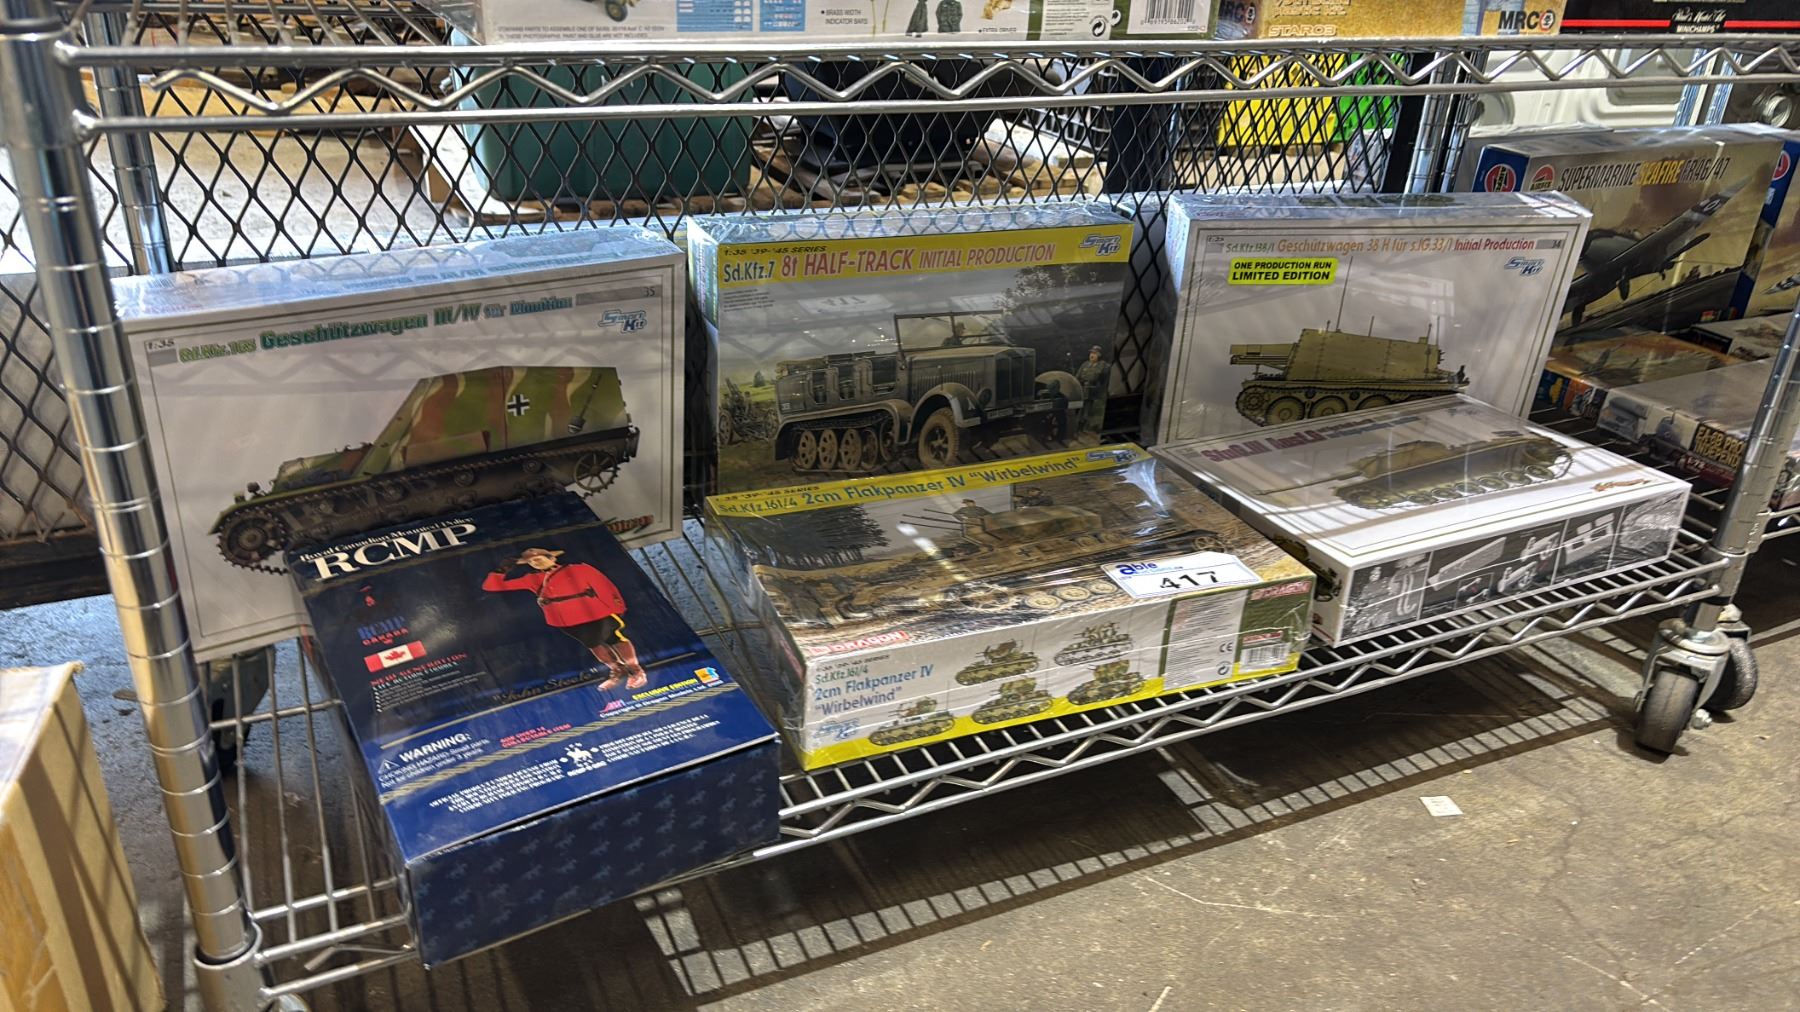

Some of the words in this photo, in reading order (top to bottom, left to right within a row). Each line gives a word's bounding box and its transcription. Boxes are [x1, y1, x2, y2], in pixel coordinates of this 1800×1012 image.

[1498, 11, 1539, 30] MRC
[1557, 163, 1641, 192] SUPERMARINE
[1637, 160, 1686, 187] SEAFIRE
[790, 246, 828, 254] SERIES
[1454, 238, 1481, 251] Initial
[1482, 237, 1535, 250] Production
[723, 260, 775, 282] Sd.Kfz.7
[781, 254, 797, 276] 8t
[803, 248, 915, 276] HALF-TRACK
[918, 250, 961, 269] INITIAL
[966, 244, 1057, 267] PRODUCTION
[1234, 261, 1253, 270] ONE
[1254, 261, 1311, 270] PRODUCTION
[1313, 261, 1333, 269] RUN
[1232, 271, 1280, 281] LIMITED
[1282, 271, 1330, 281] EDITION
[603, 311, 645, 322] Smart
[623, 319, 645, 332] Kit
[260, 314, 429, 350] Geschützwagen
[802, 489, 841, 505] 2cm
[844, 477, 944, 500] Flakpanzer
[948, 474, 966, 489] IV
[299, 547, 335, 563] Royal
[335, 534, 390, 554] Canadian
[390, 522, 438, 541] Mounted
[439, 516, 475, 531] Police
[314, 523, 478, 582] RCMP
[1115, 562, 1158, 576] able
[1160, 571, 1219, 589] 417
[830, 631, 903, 653] DRAGON
[632, 685, 669, 701] EXCLUSIVE
[668, 678, 699, 692] EDITION
[815, 686, 841, 701] 2cm
[846, 671, 918, 693] Flakpanzer
[919, 663, 935, 679] IV
[599, 704, 635, 718] Copyright
[399, 732, 471, 763] WARNING:
